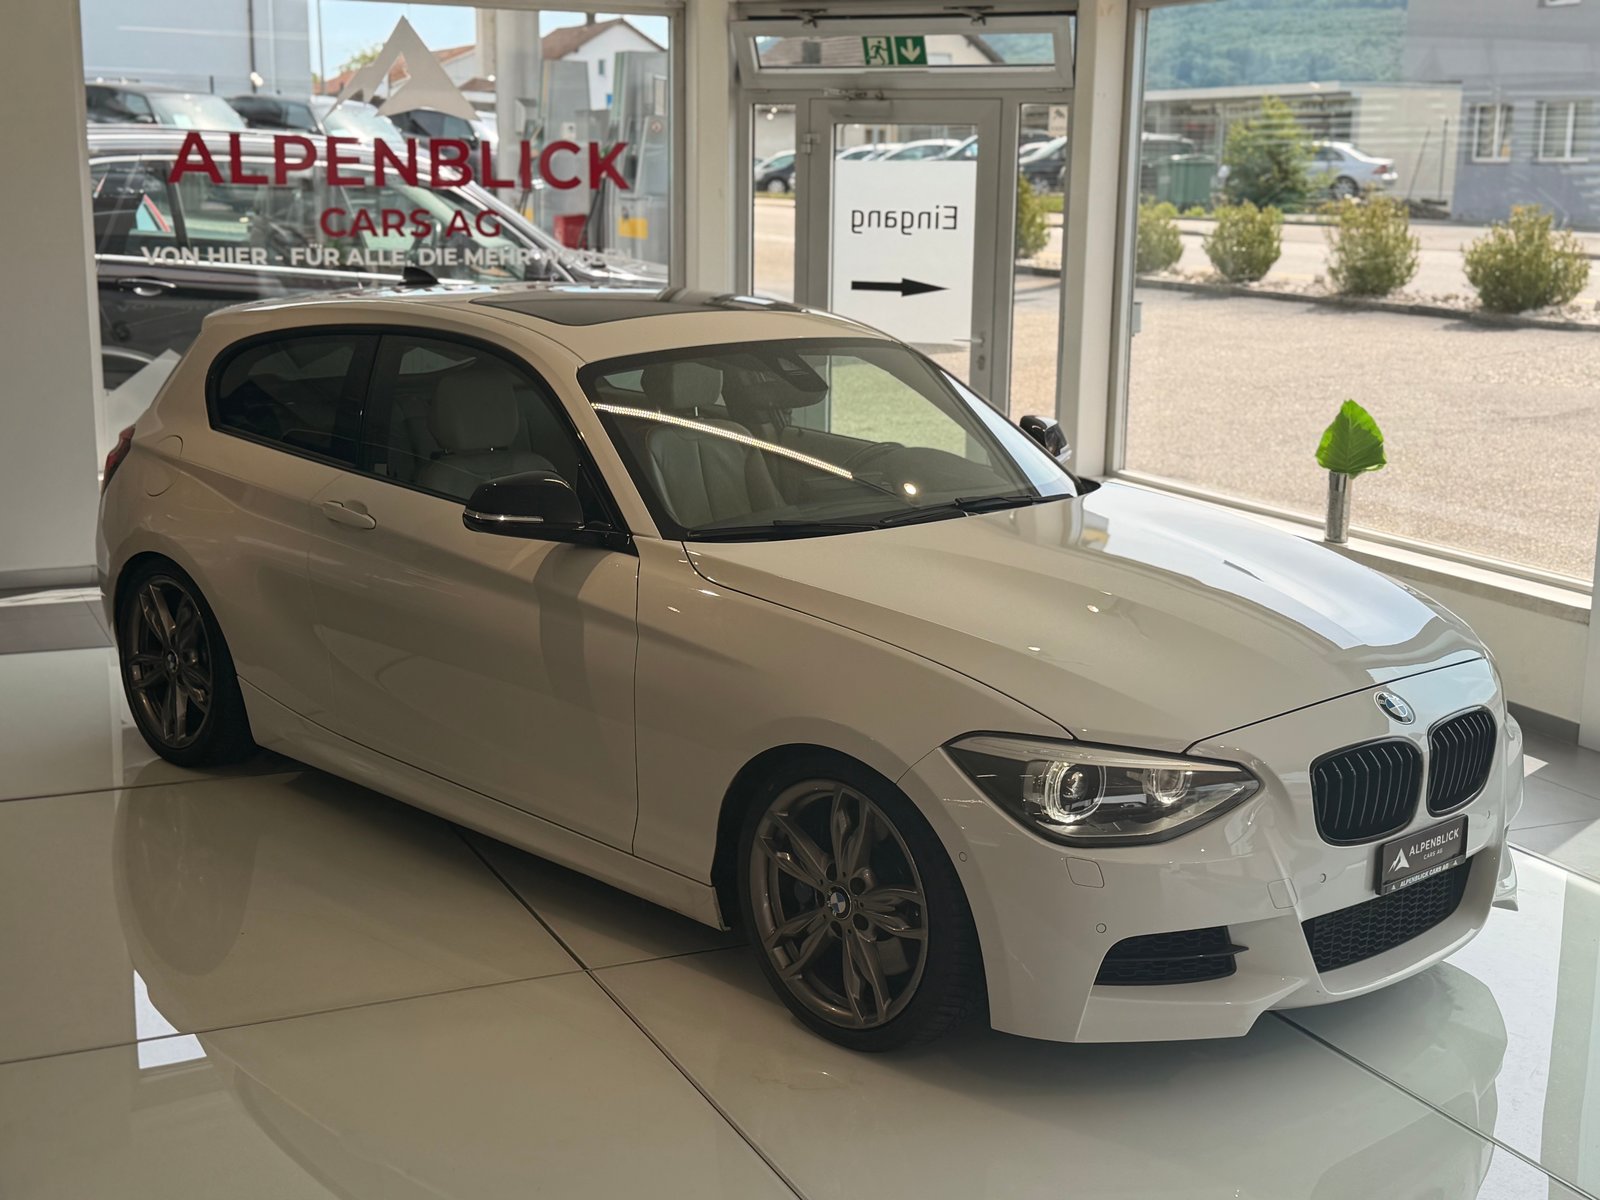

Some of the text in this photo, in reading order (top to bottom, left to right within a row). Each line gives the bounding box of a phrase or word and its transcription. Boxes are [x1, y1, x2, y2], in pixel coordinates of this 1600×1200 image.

[168, 131, 630, 190] ALPENBLICK
[320, 207, 502, 238] CARS AG
[140, 246, 200, 266] VON
[208, 246, 268, 266] HIER
[291, 243, 340, 266] FÜR
[418, 247, 458, 267] DIE
[464, 247, 531, 267] MEHR
[1409, 828, 1460, 856] ALPENBLICK
[1423, 850, 1436, 860] CARS
[1400, 871, 1429, 887] ALPENBLICK
[1429, 866, 1442, 876] CARS
